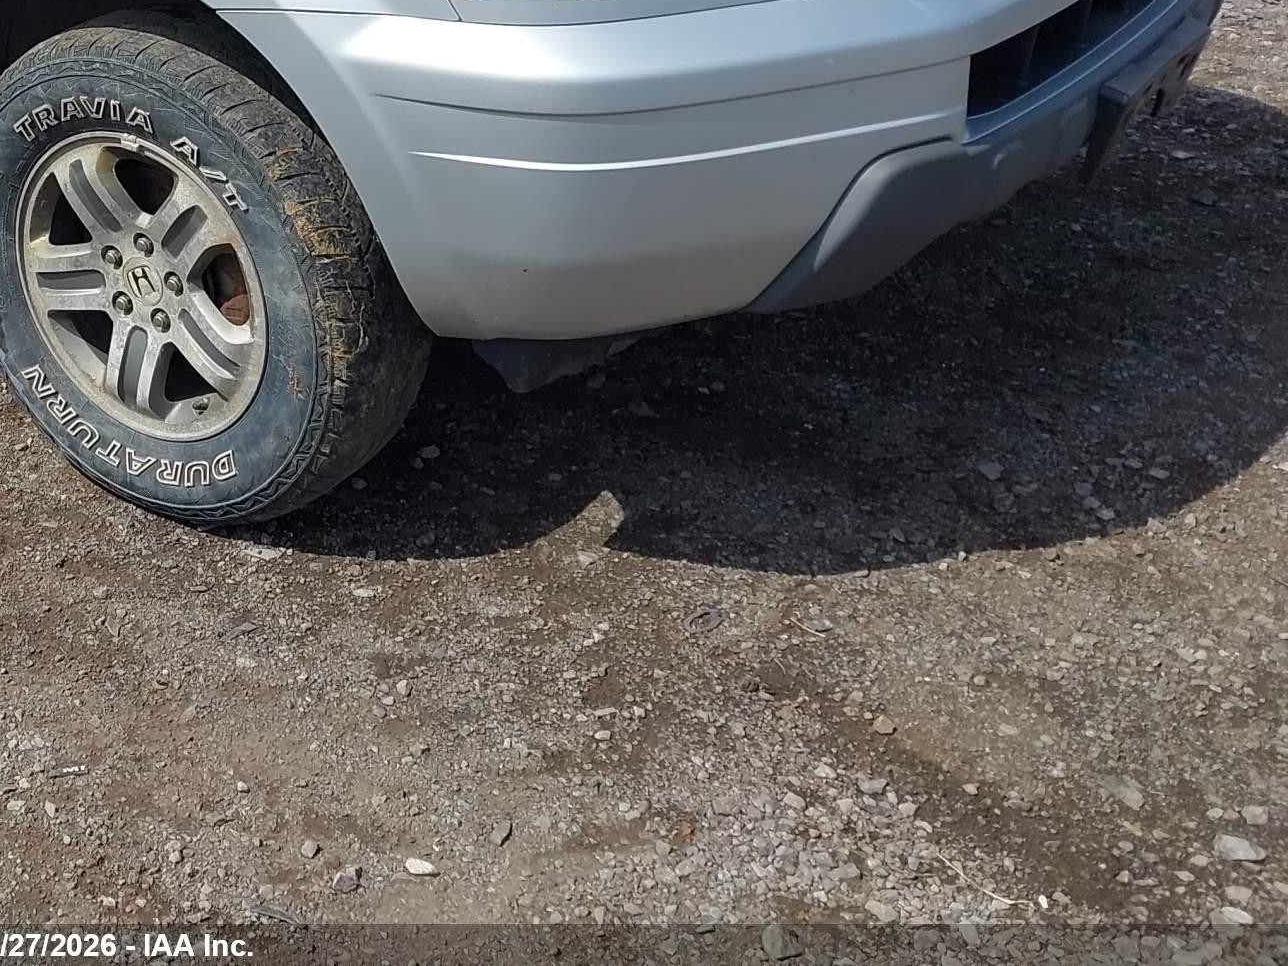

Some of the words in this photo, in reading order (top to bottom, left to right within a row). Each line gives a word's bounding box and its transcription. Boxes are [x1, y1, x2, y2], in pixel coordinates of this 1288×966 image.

[13, 96, 155, 142] TRAVIA
[170, 136, 249, 211] A/T
[21, 363, 238, 487] DURATURN
